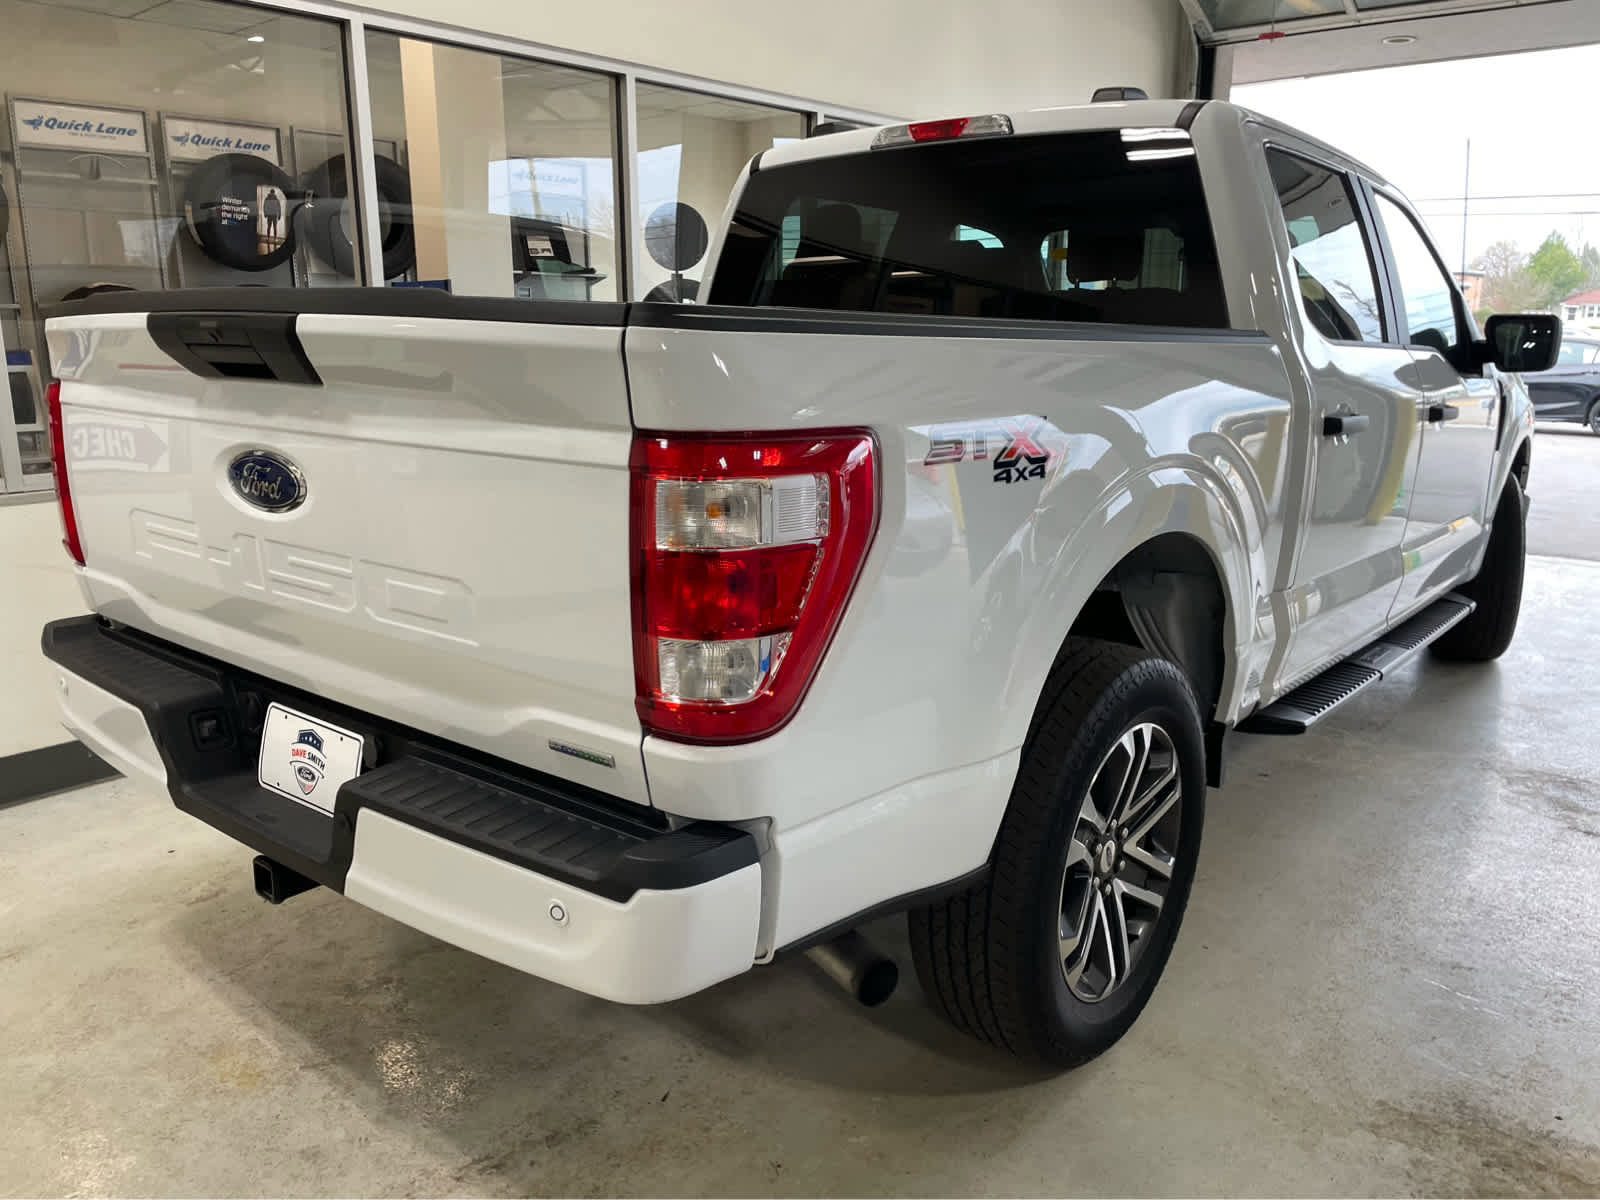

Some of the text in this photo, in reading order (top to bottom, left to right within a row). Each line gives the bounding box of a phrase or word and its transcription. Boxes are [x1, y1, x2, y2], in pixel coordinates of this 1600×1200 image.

[44, 117, 94, 132] Quick
[96, 122, 137, 136] Lane
[190, 133, 232, 148] Quick
[235, 138, 271, 151] Lane
[240, 461, 282, 500] Ford
[291, 748, 326, 771] DAVE SMITH
